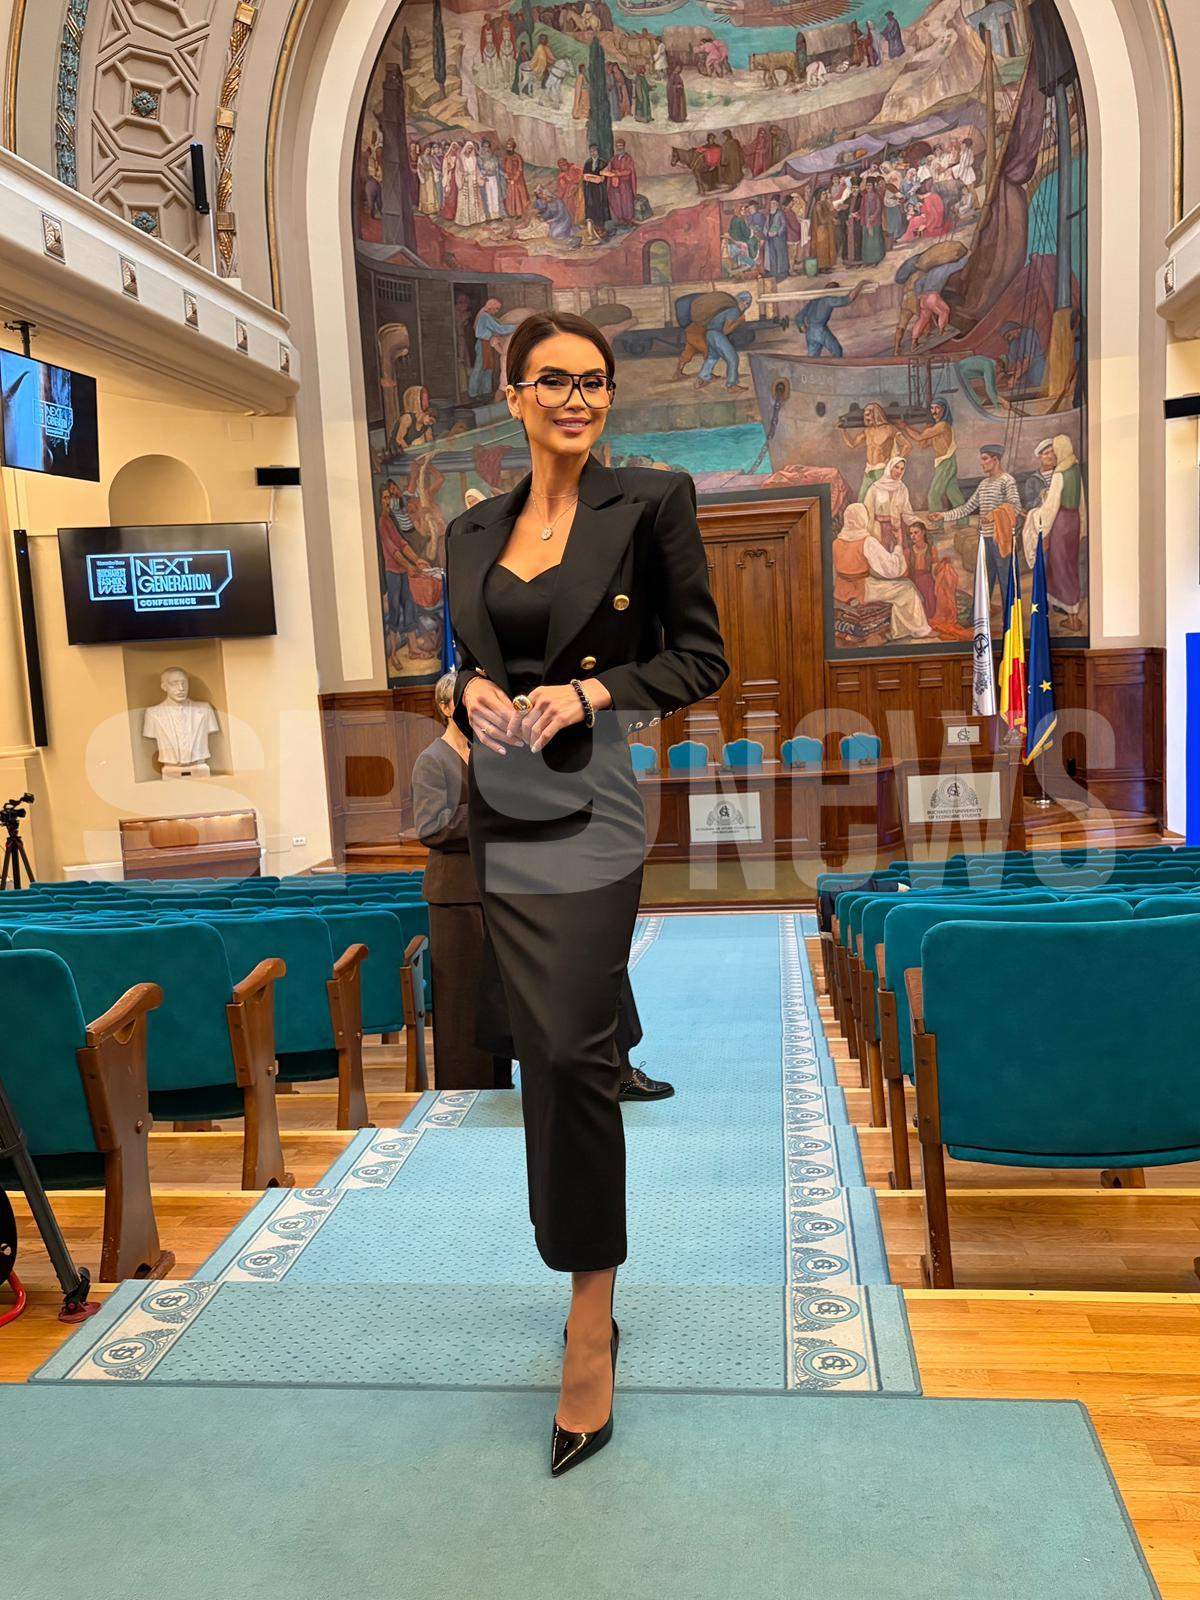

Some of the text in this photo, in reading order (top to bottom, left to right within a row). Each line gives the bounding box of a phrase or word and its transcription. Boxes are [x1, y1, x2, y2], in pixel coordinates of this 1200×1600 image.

[136, 558, 193, 576] NEXT
[97, 577, 127, 586] FASHION
[138, 574, 212, 593] GENERATION
[98, 584, 127, 595] WEEK
[140, 598, 197, 607] CONFERENCE
